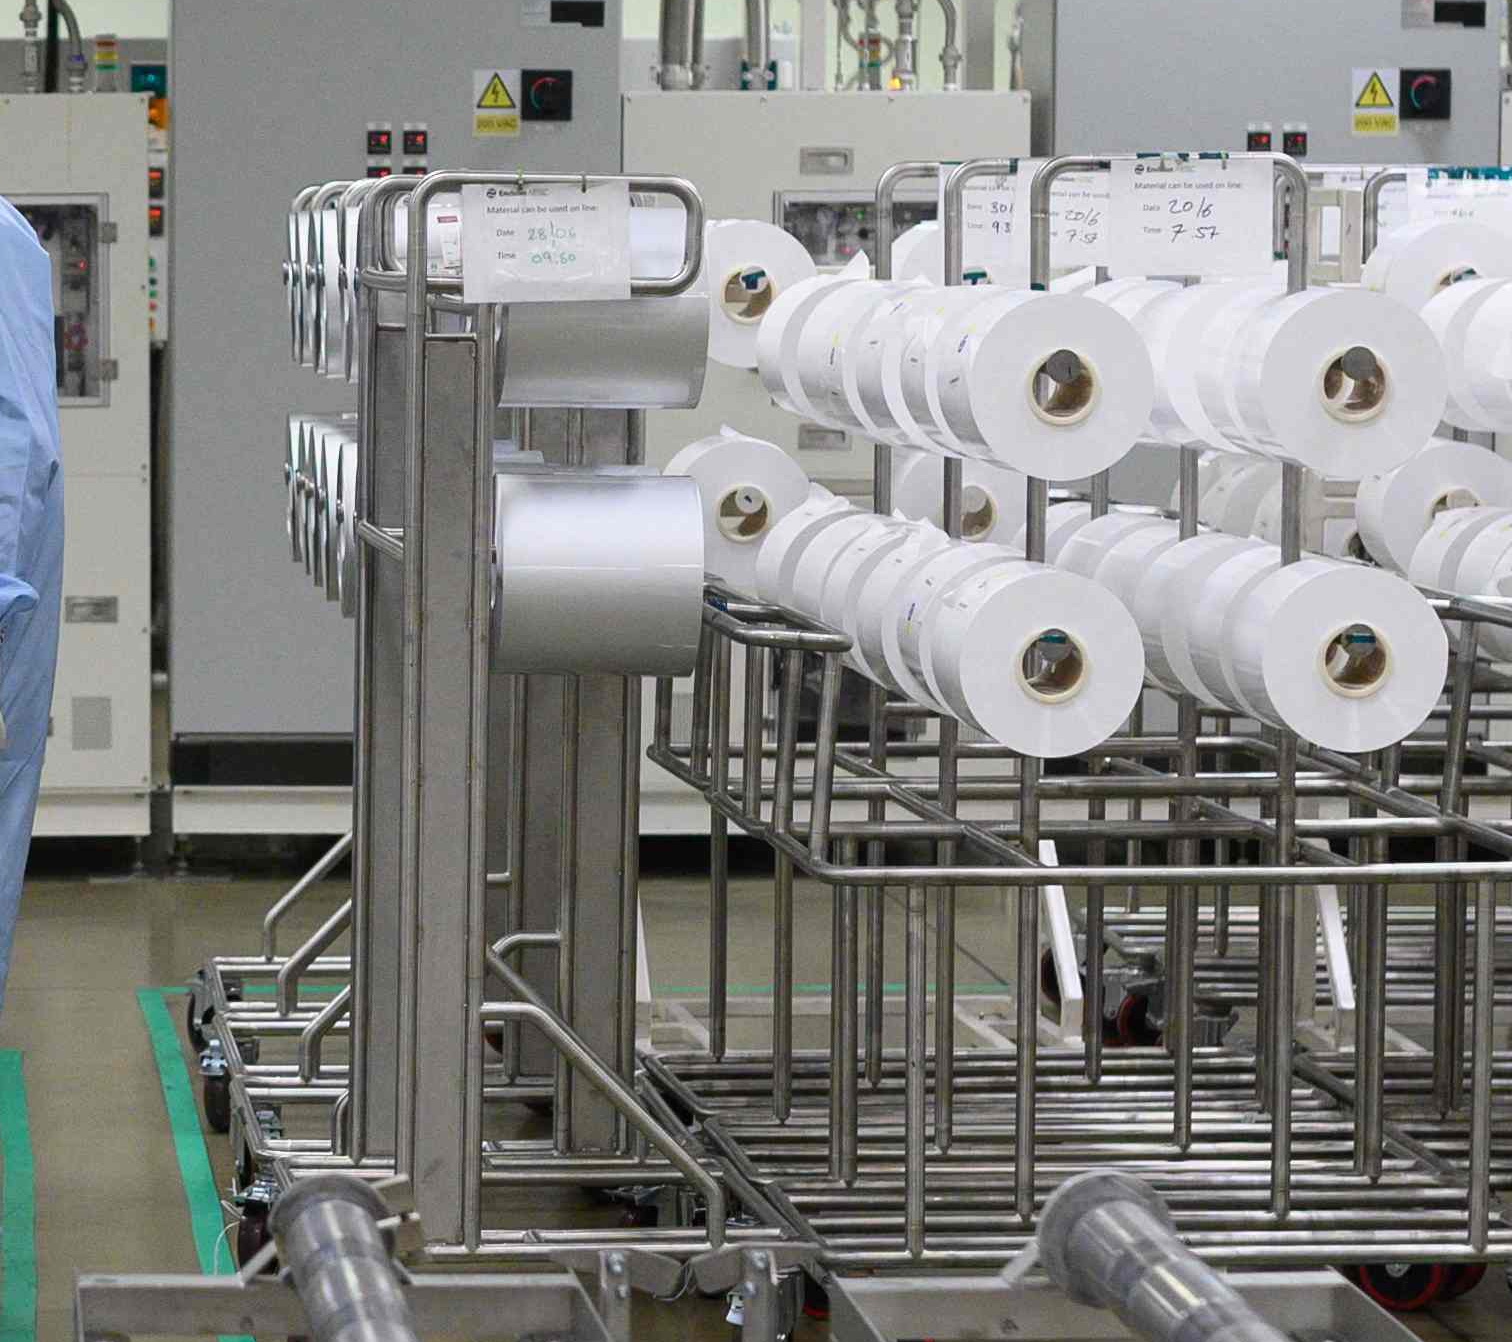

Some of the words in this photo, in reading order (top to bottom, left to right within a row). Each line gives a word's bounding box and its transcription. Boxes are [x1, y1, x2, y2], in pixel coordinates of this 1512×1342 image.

[1134, 182, 1167, 190] Material
[1183, 181, 1193, 189] be
[1195, 181, 1214, 189] used
[487, 205, 520, 214] Material
[537, 205, 547, 213] be
[549, 204, 568, 213] used
[569, 206, 580, 214] on
[1168, 196, 1214, 219] 20/6
